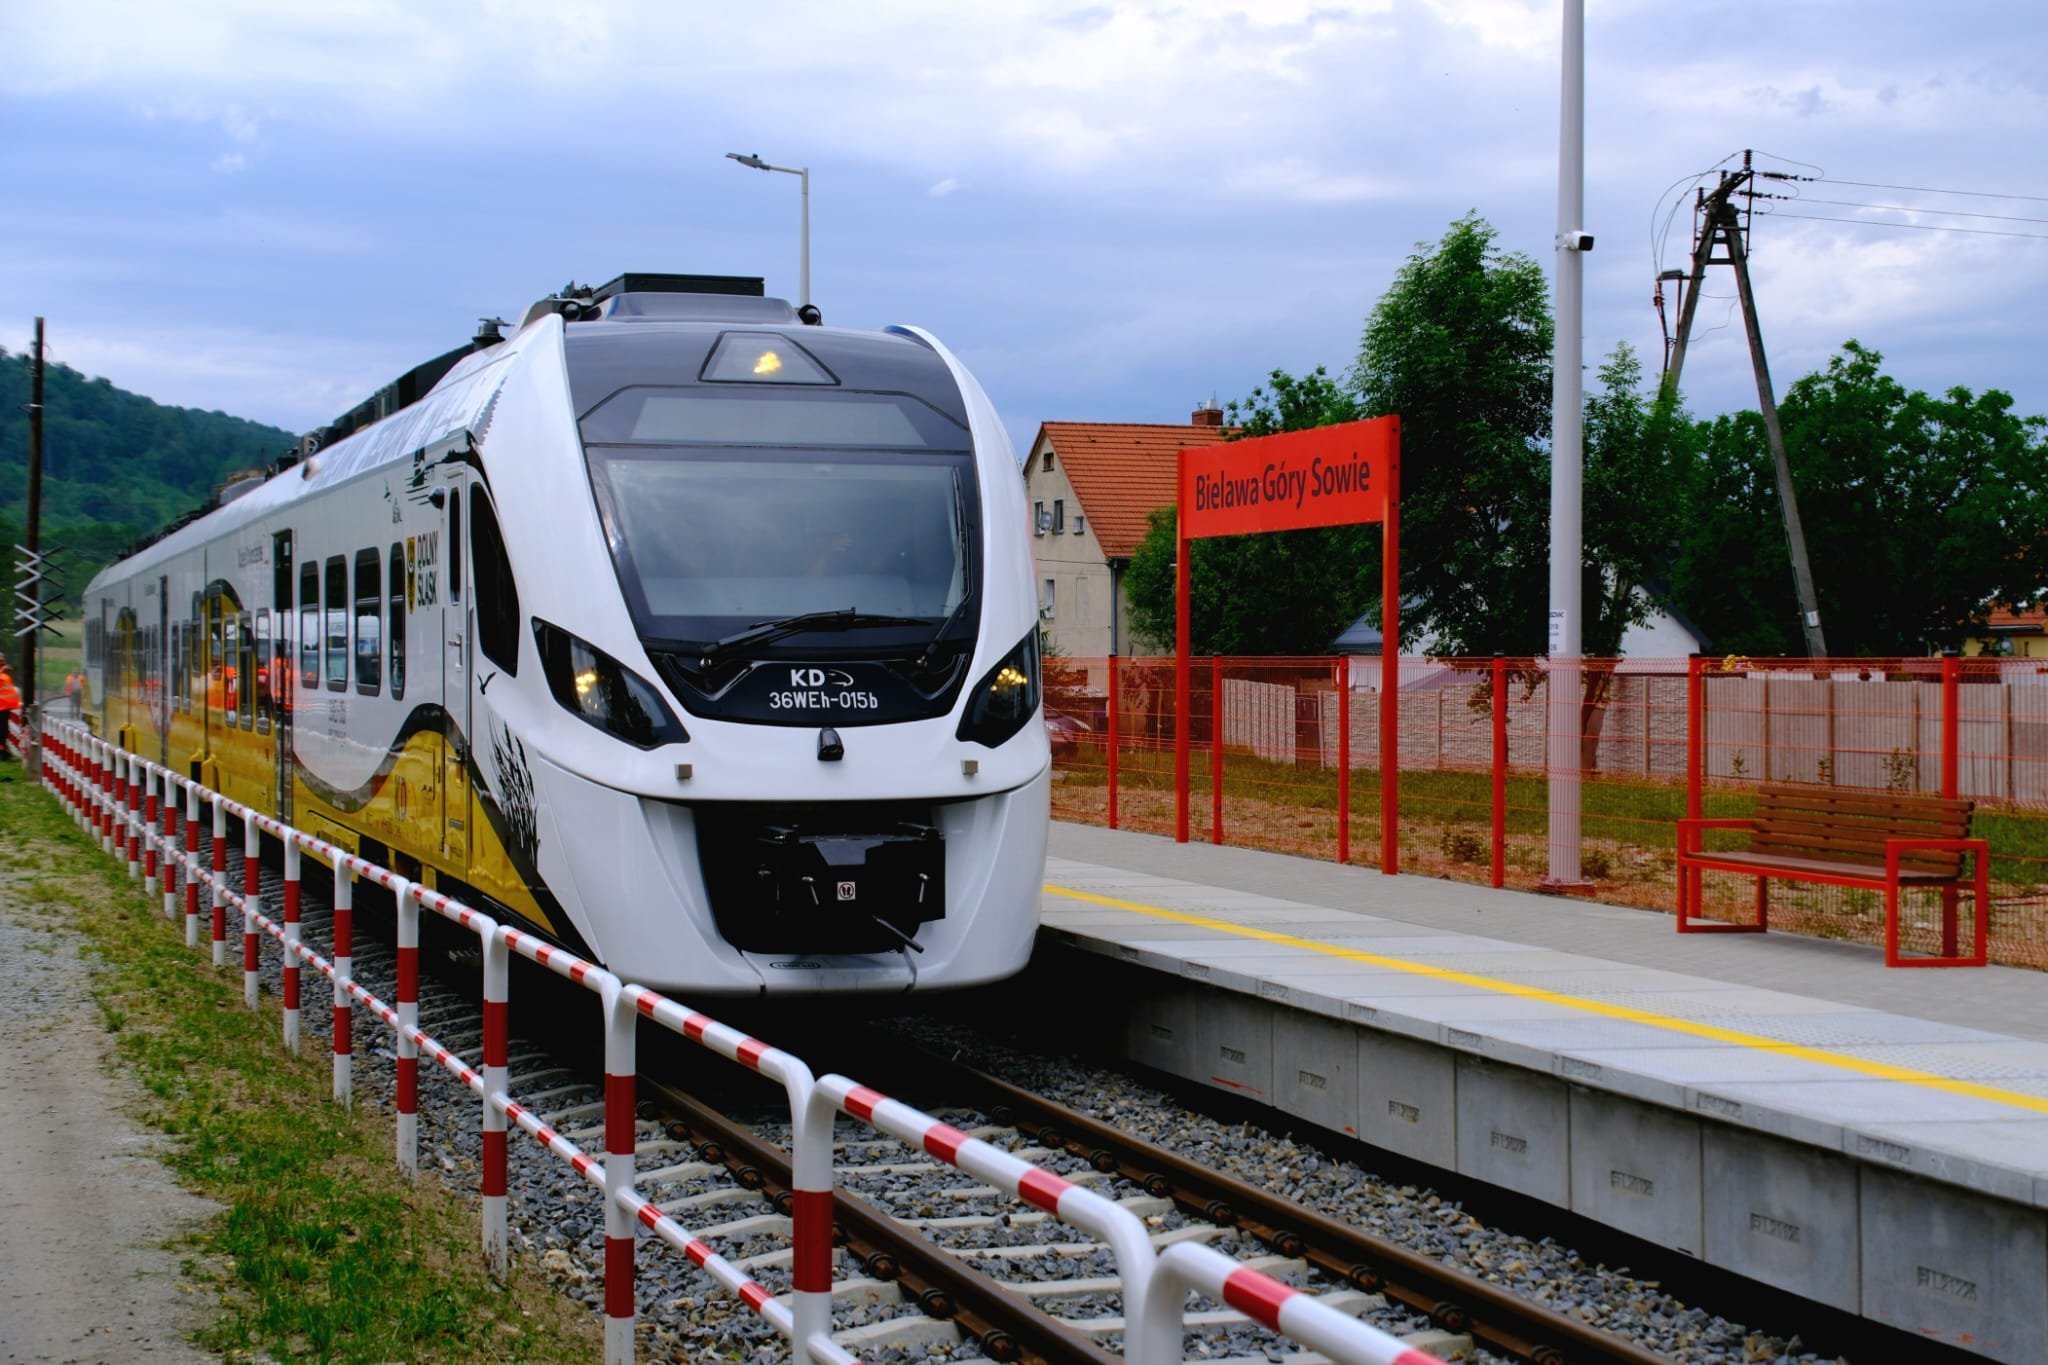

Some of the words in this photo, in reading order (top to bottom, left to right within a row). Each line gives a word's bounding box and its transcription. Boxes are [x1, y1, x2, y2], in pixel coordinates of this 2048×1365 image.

[1196, 470, 1260, 511] Bielawa
[1263, 461, 1307, 510] Góry
[1311, 452, 1370, 497] Sowie
[790, 669, 826, 687] KD
[770, 692, 878, 708] 36WEh-015b
